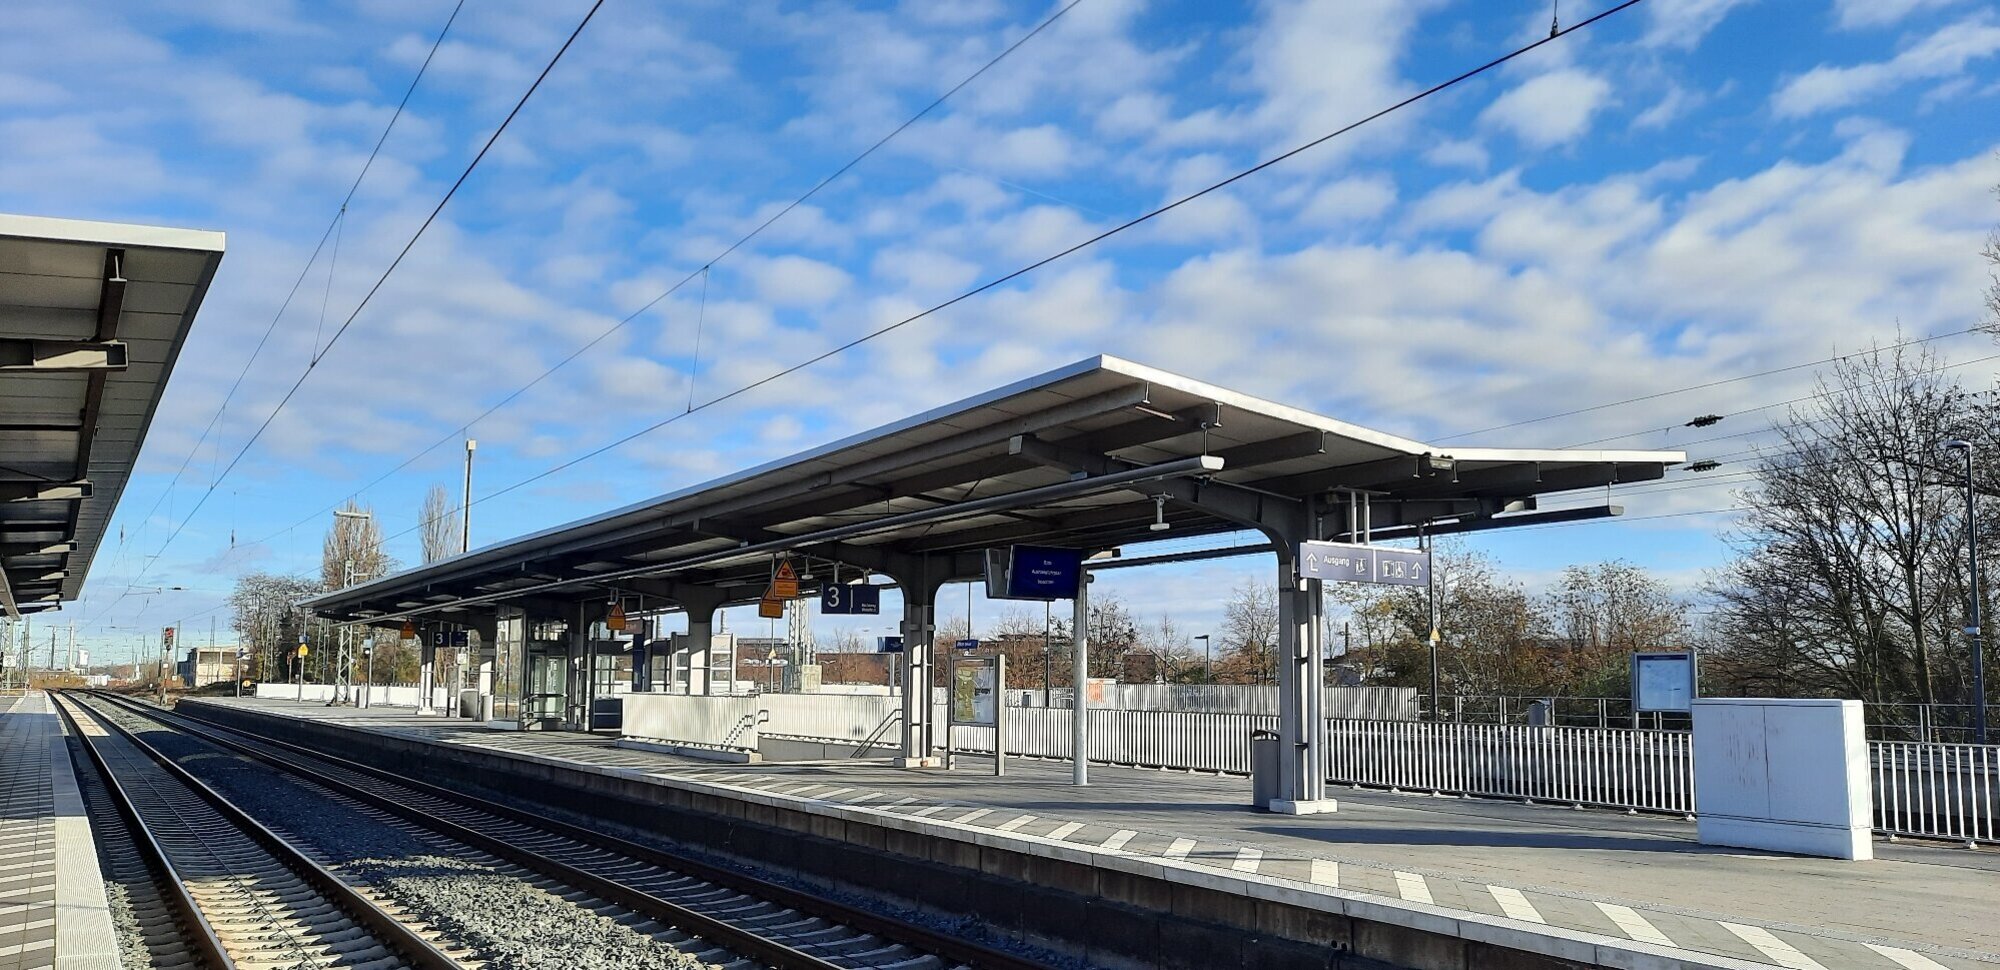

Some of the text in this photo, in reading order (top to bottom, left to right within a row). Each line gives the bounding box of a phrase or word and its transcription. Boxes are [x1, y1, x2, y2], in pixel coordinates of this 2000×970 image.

[1323, 555, 1350, 567] Ausgang
[827, 586, 840, 608] 3
[435, 633, 444, 645] 3
